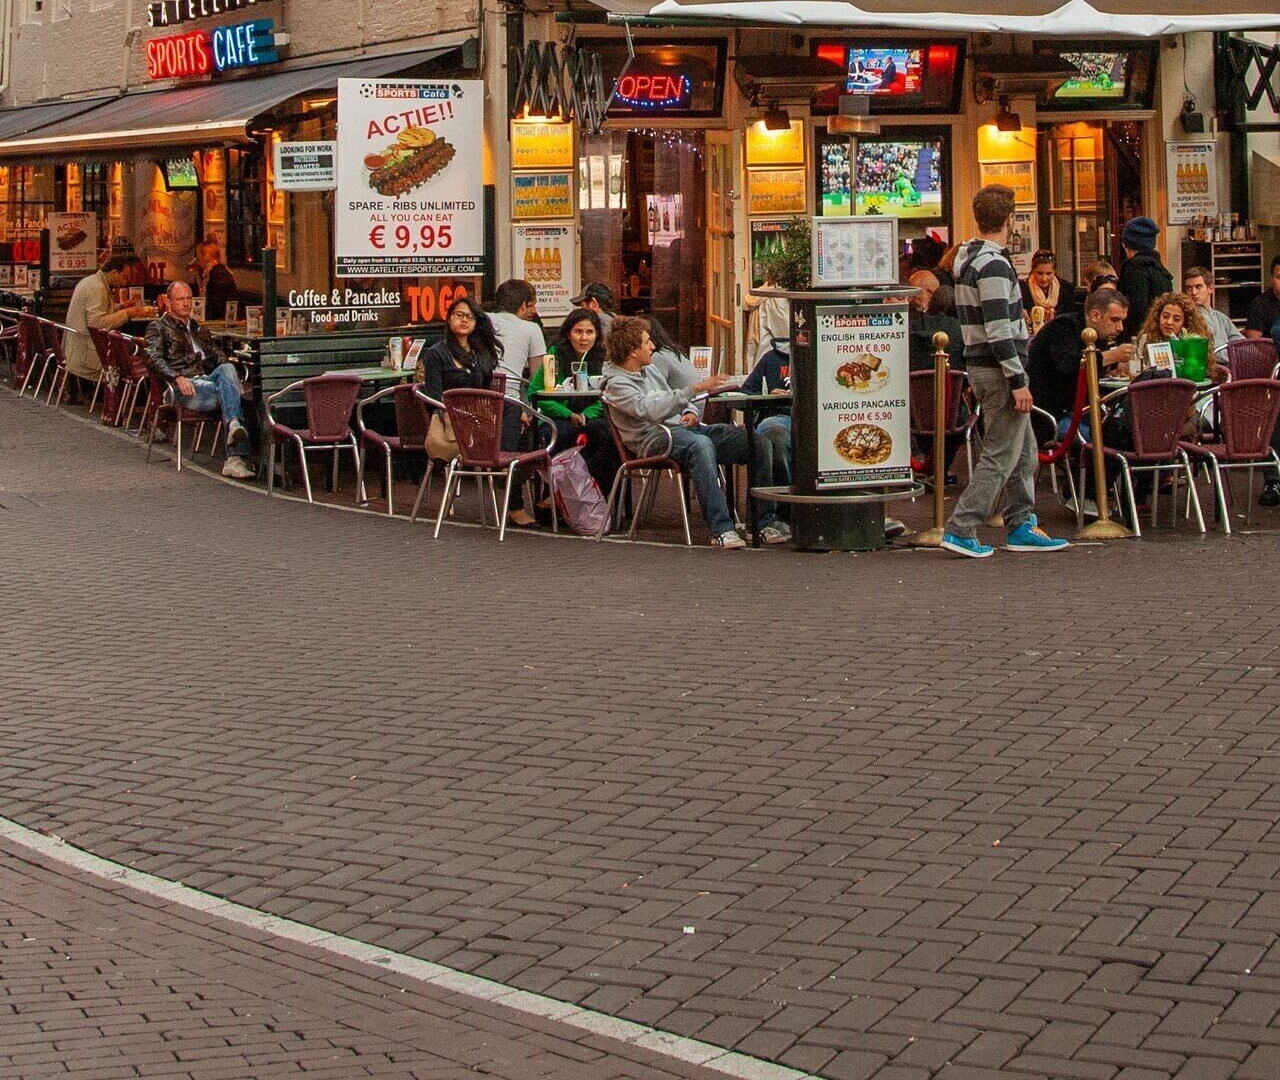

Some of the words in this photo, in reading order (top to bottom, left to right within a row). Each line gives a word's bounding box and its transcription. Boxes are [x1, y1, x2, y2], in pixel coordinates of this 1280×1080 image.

[147, 33, 207, 76] SPORTS
[213, 23, 259, 68] CAFE
[619, 75, 684, 100] OPEN
[376, 88, 418, 98] SPORTS
[422, 89, 446, 99] Café
[366, 101, 455, 140] ACTIE!!
[280, 146, 304, 154] LOOKING
[304, 145, 316, 153] FOR
[348, 201, 384, 211] SPARE
[392, 201, 418, 211] RIBS
[419, 201, 476, 211] UNLIMITED
[369, 213, 389, 222] ALL
[390, 213, 411, 222] YOU
[412, 213, 434, 222] CAN
[435, 213, 454, 221] EAT
[368, 224, 387, 249] €
[394, 224, 453, 253] 9,95
[347, 265, 476, 274] WWW.SATELLITESPORTSCAFE.COM
[288, 289, 328, 307] Coffee
[331, 288, 341, 306] &
[344, 287, 401, 306] Pancakes
[408, 285, 435, 322] TO
[311, 310, 332, 323] Food
[333, 310, 350, 322] and
[351, 310, 379, 322] Drinks
[835, 319, 868, 328] SPORTS
[870, 318, 891, 326] Café
[821, 333, 856, 342] ENGLISH
[859, 331, 906, 341] BREAKFAST
[836, 344, 864, 354] FROM
[865, 344, 871, 353] €
[822, 401, 860, 411] VARIOUS
[861, 399, 907, 409] PANCAKES
[838, 413, 865, 423] FROM
[867, 412, 872, 422] €
